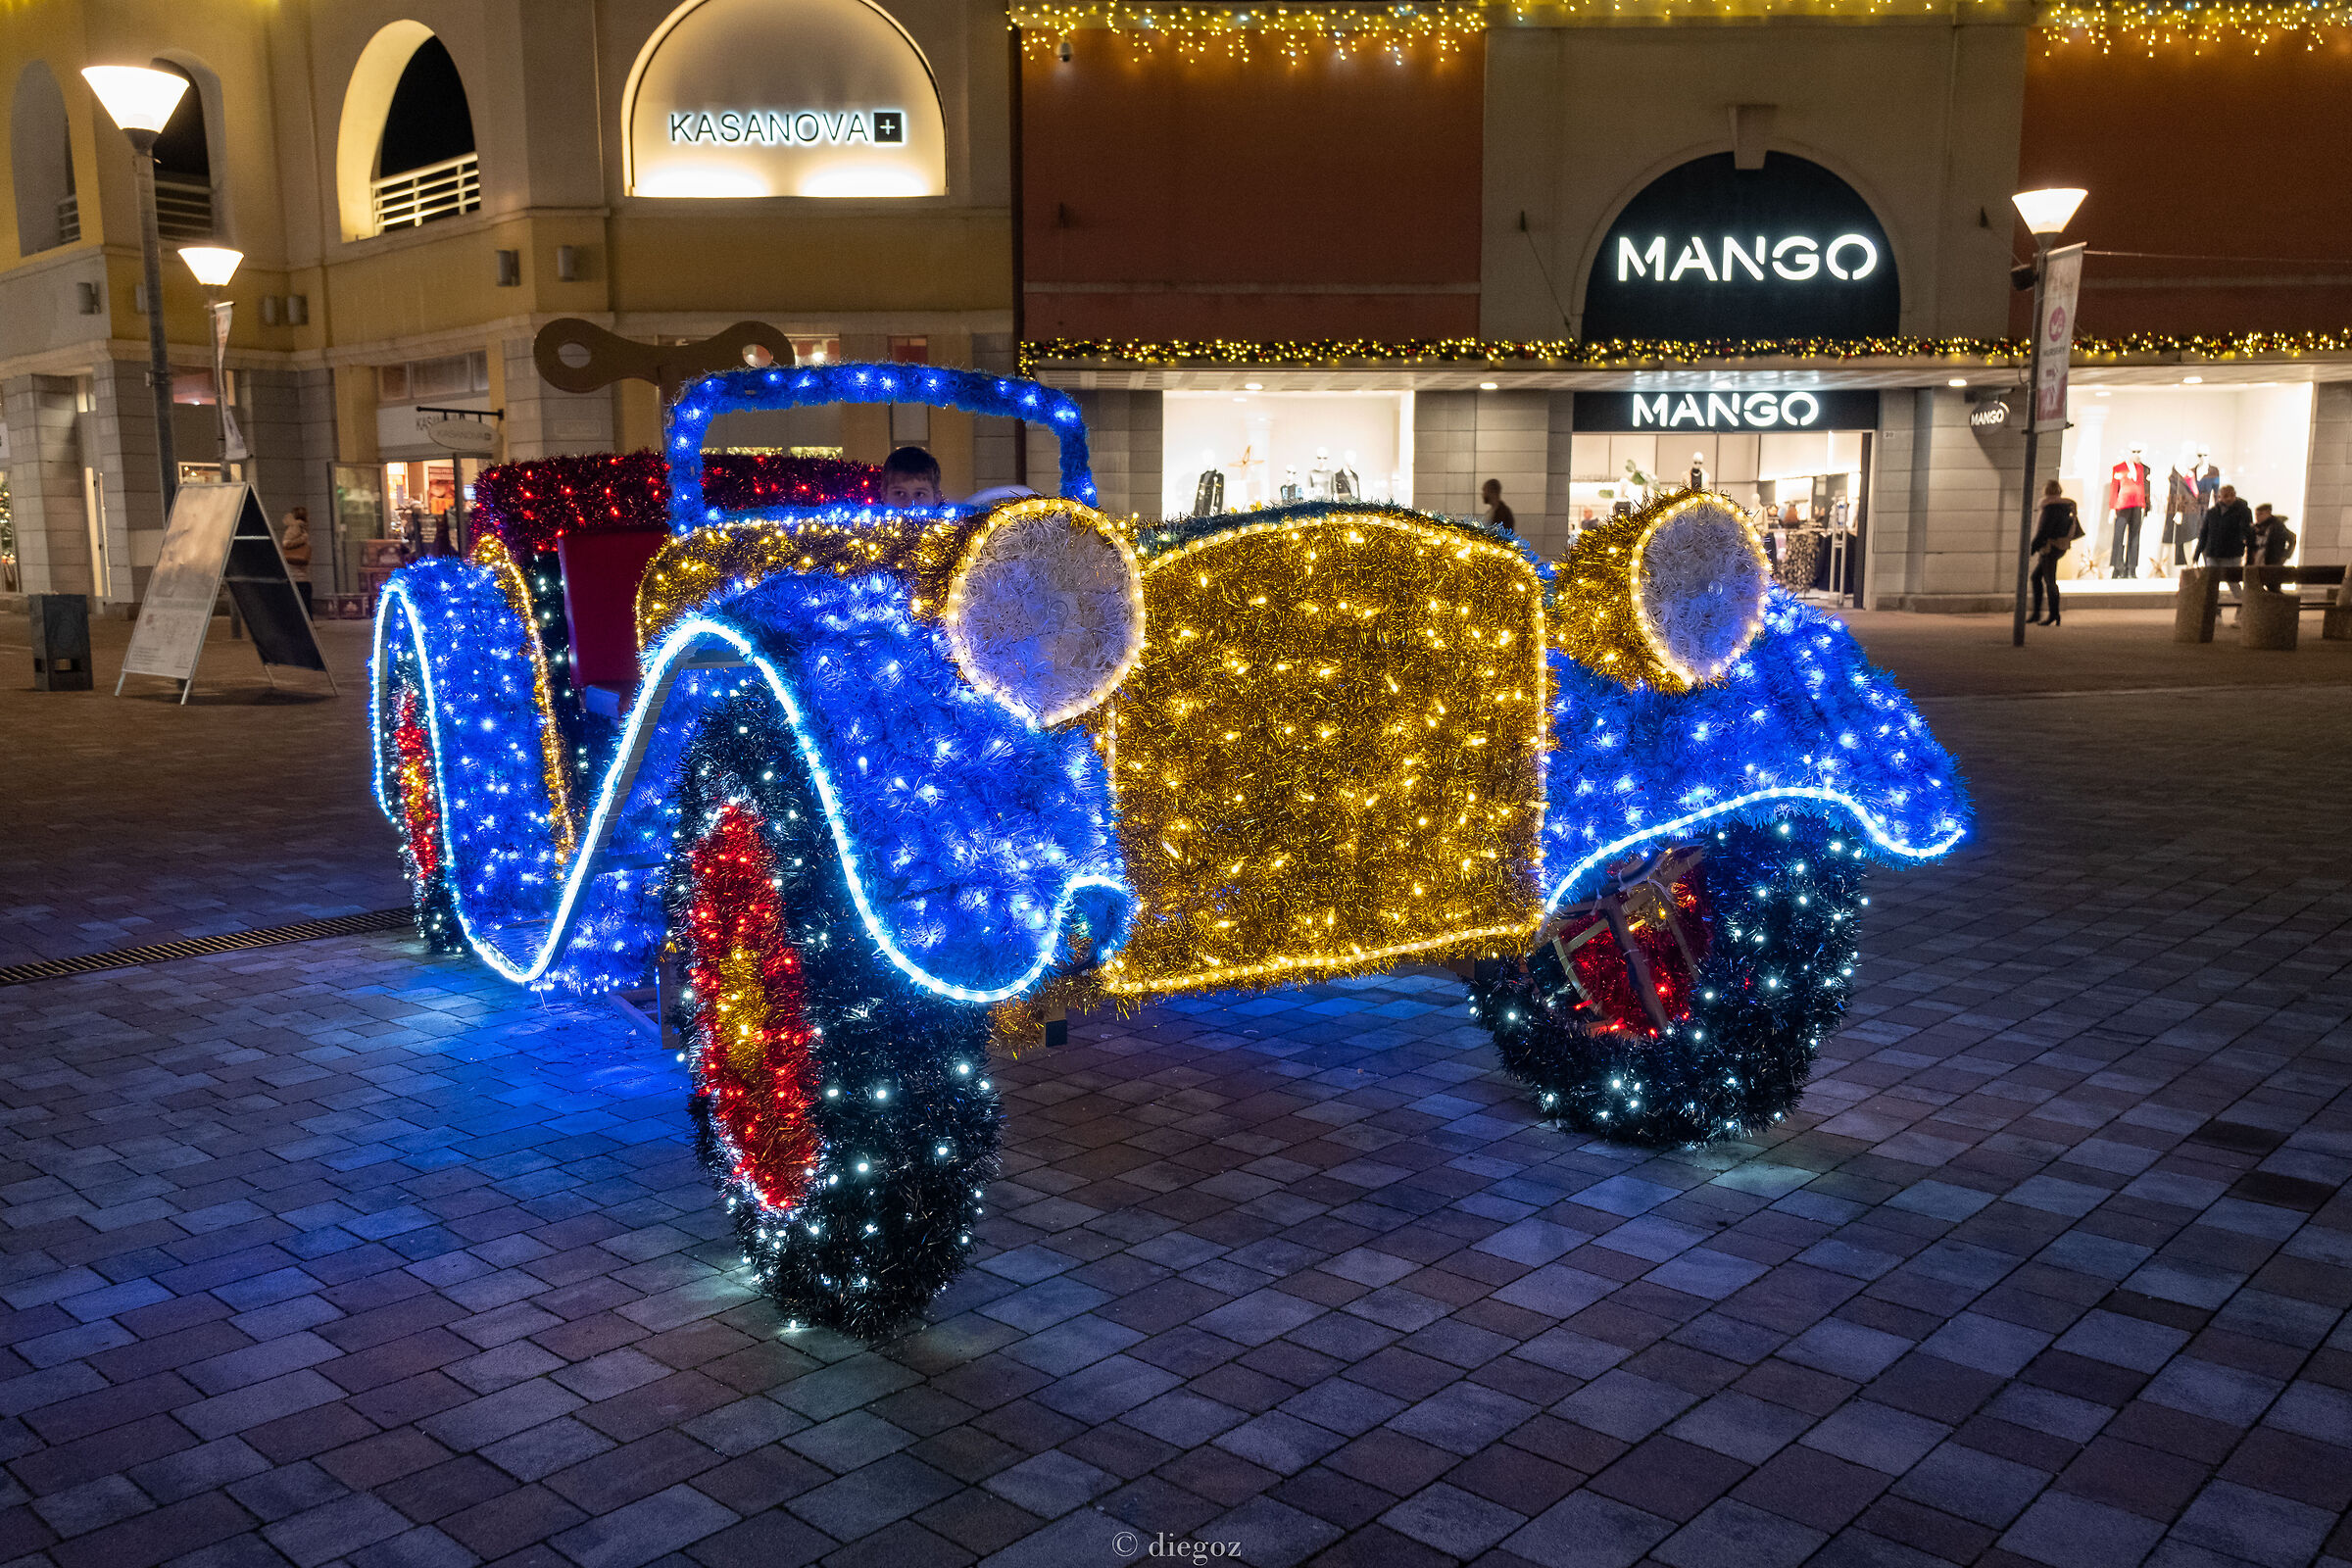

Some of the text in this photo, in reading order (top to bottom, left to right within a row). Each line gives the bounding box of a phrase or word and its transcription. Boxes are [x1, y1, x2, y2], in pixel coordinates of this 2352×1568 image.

[1617, 233, 1878, 281] MANGO
[1632, 392, 1820, 427] MANGO
[1970, 409, 2004, 426] MANGO
